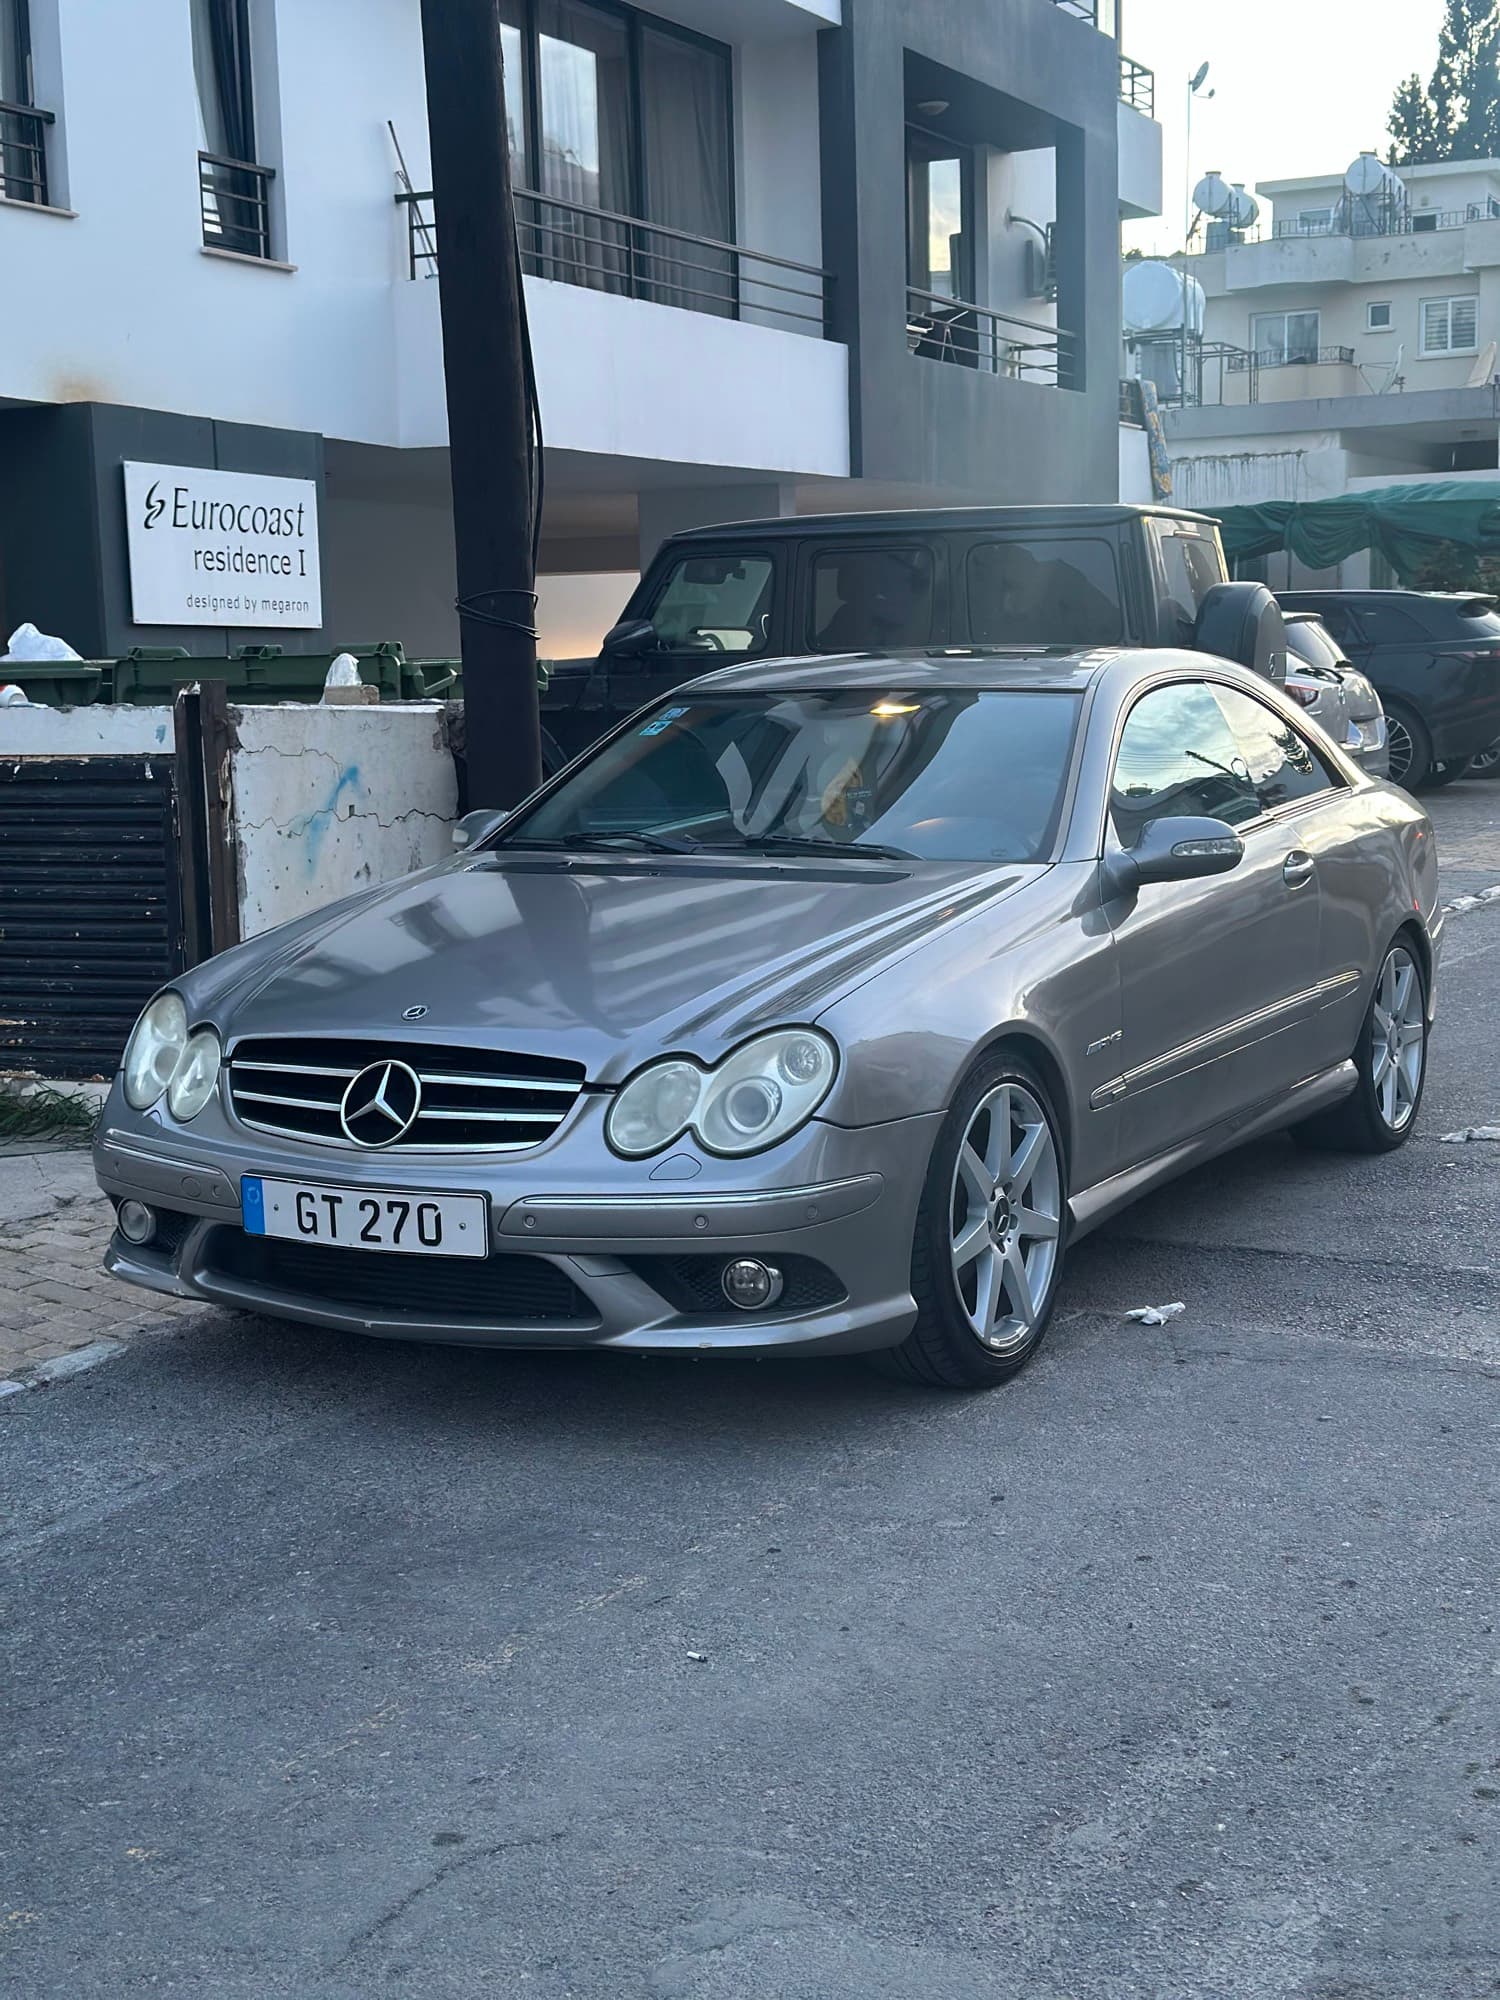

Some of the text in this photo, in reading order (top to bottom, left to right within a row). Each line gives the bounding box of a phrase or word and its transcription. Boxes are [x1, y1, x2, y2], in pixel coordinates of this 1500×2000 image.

[172, 487, 304, 537] Eurocoast
[194, 545, 306, 576] residence I
[186, 594, 310, 614] designed by megaron
[295, 1191, 443, 1248] GT 270
